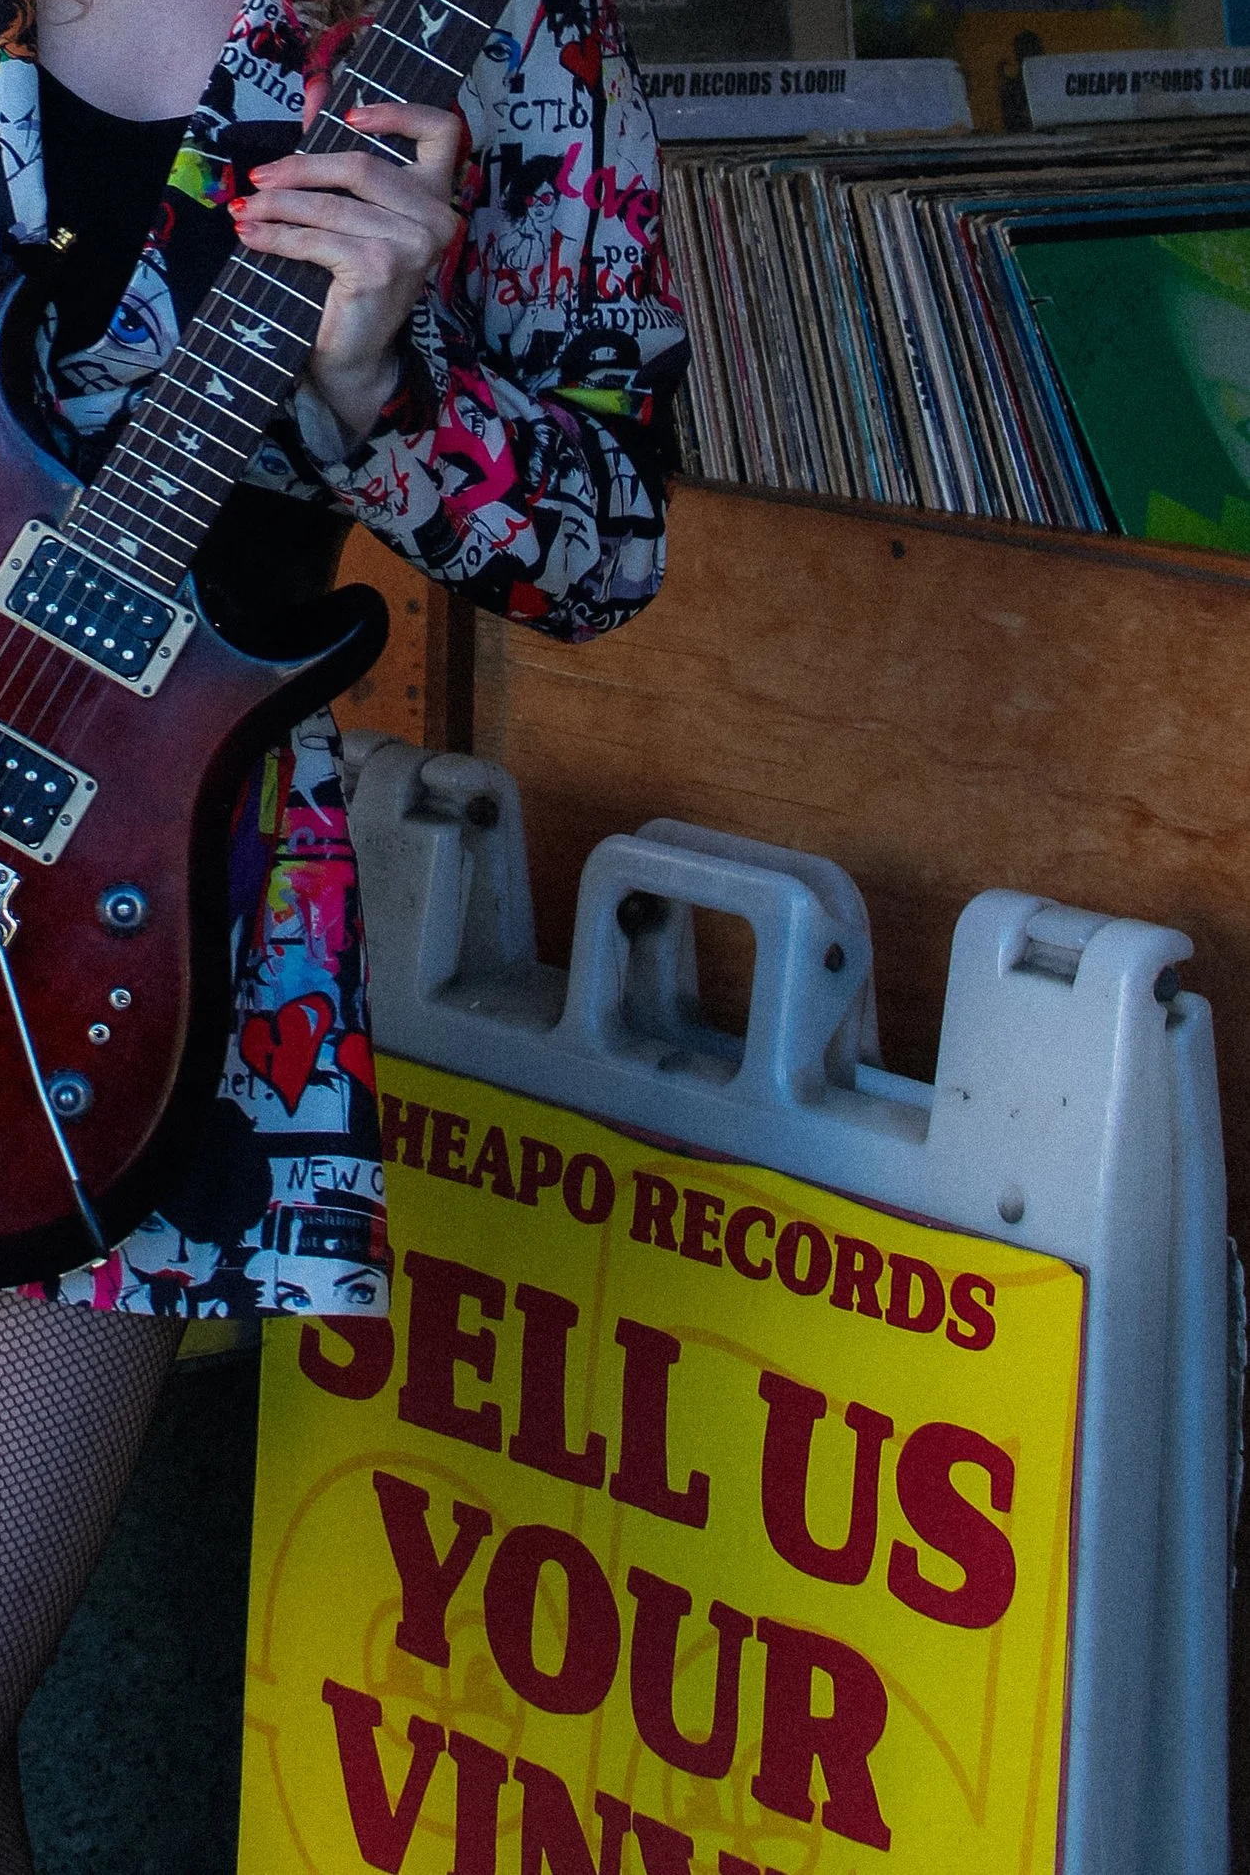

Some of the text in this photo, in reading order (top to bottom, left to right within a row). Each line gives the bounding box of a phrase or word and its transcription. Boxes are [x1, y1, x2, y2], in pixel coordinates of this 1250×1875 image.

[688, 71, 772, 98] RECORDS
[1065, 71, 1128, 97] CHEAPO
[629, 1170, 999, 1353] RECORDS
[758, 1369, 1017, 1631] US
[372, 1468, 893, 1852] YOUR
[321, 1677, 778, 1875] VIN
